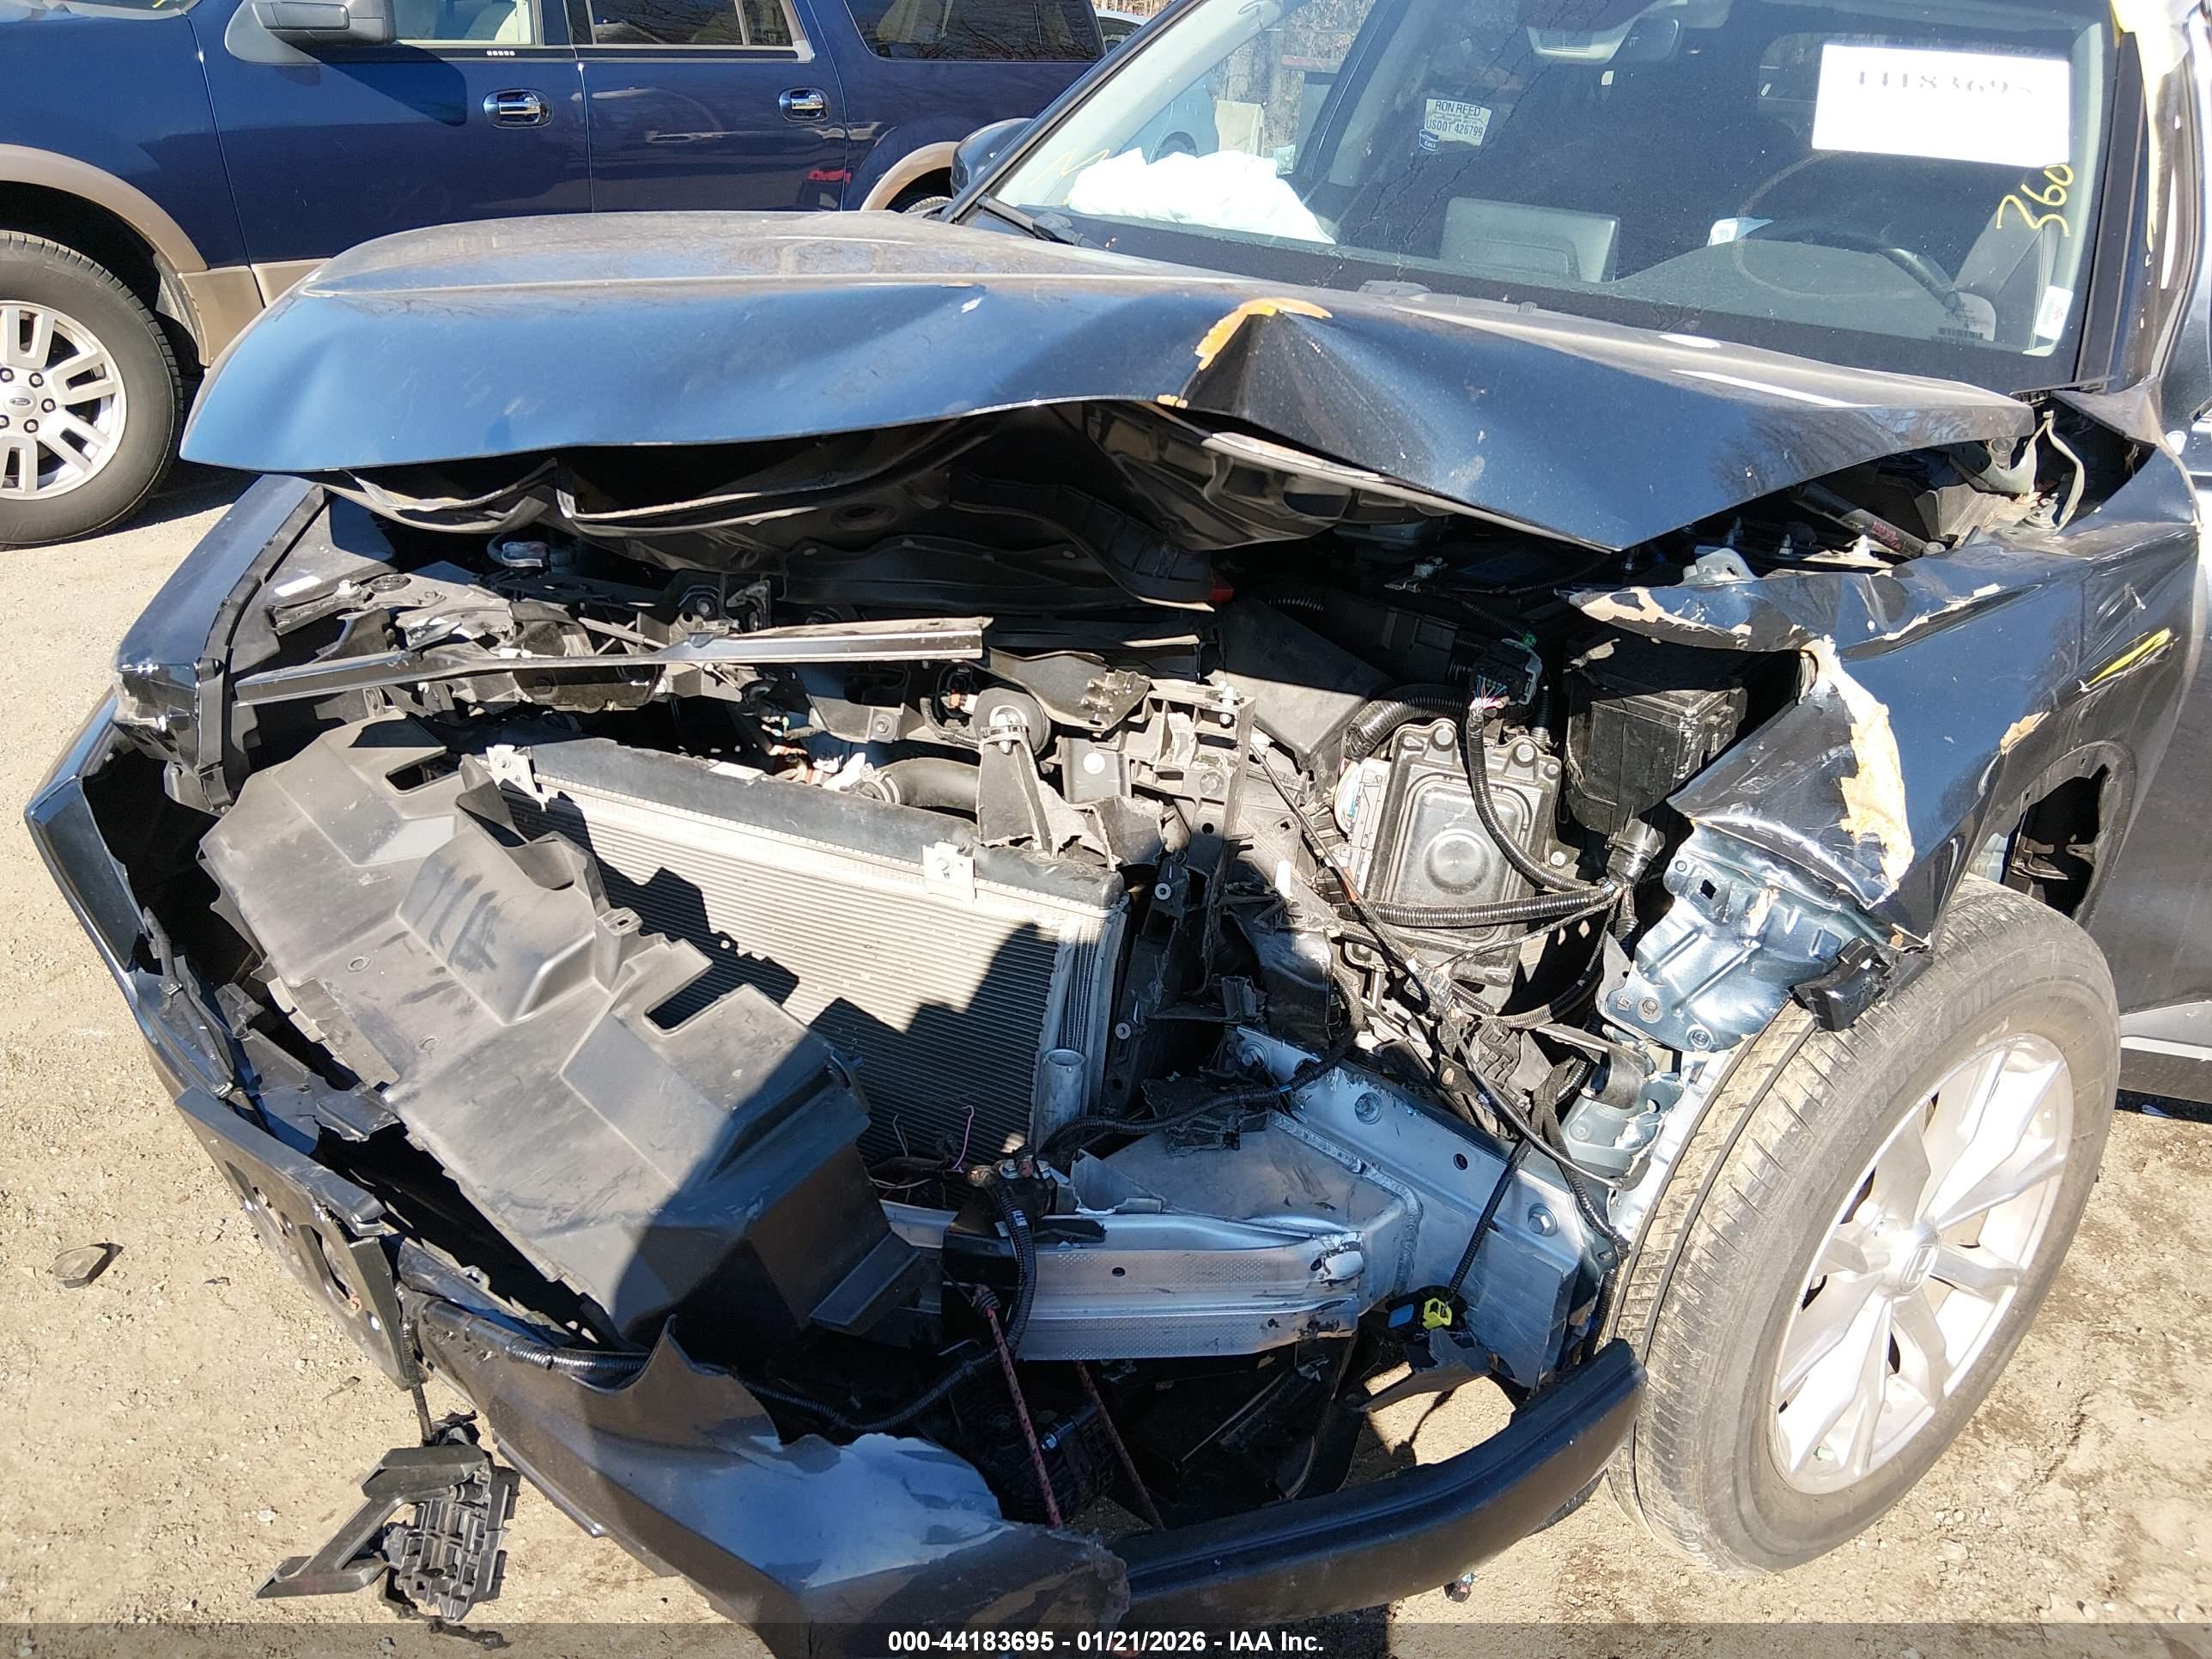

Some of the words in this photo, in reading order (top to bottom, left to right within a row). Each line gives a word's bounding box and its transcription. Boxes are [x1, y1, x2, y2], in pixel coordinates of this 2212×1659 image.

[1435, 100, 1455, 112] RON
[1455, 103, 1481, 117] REED
[1425, 118, 1453, 132] USDOT
[1454, 123, 1484, 137] 426799
